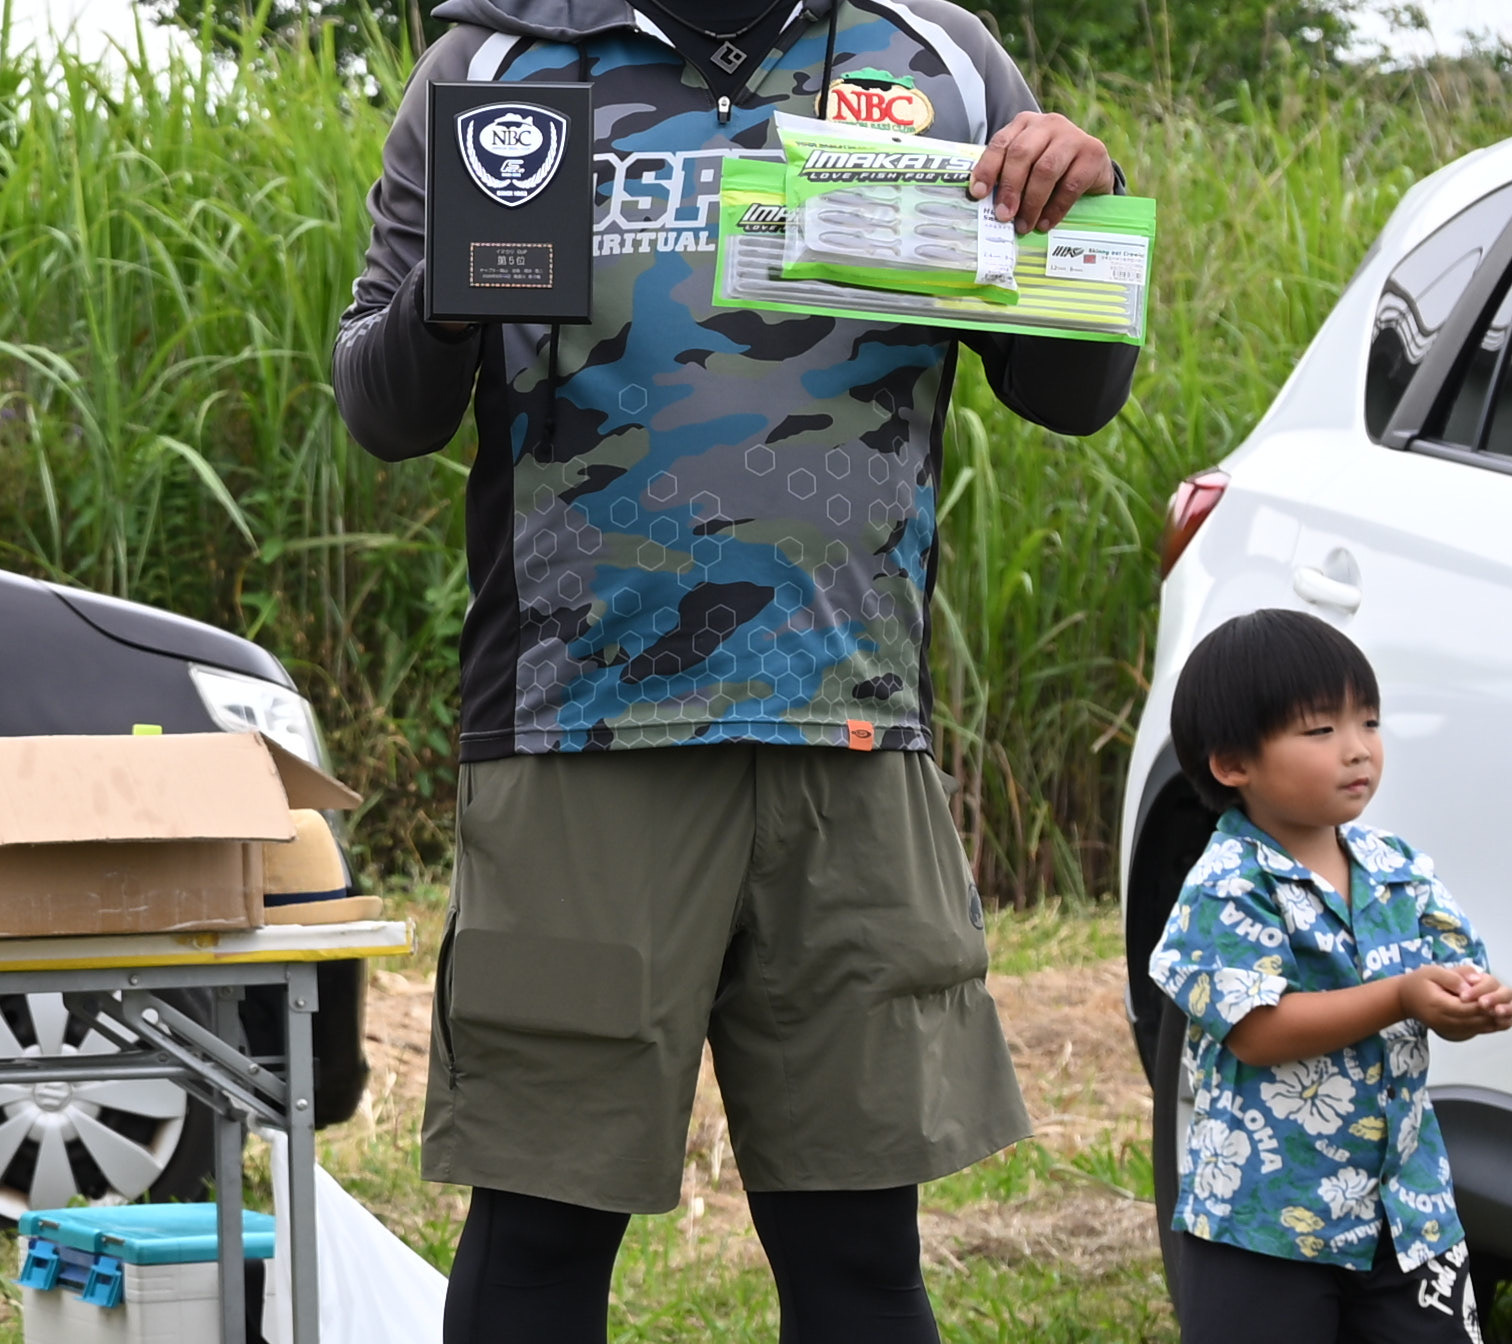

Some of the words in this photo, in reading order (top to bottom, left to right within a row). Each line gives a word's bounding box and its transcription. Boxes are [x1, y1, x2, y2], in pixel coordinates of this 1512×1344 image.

[832, 89, 914, 126] NBC
[492, 130, 532, 146] NBC
[805, 150, 980, 171] IMAKATS
[809, 172, 853, 180] LOVE
[859, 172, 897, 180] FISH
[905, 172, 934, 180] FOR
[593, 231, 716, 256] IRITUAL
[1217, 1090, 1282, 1174] ALOHA
